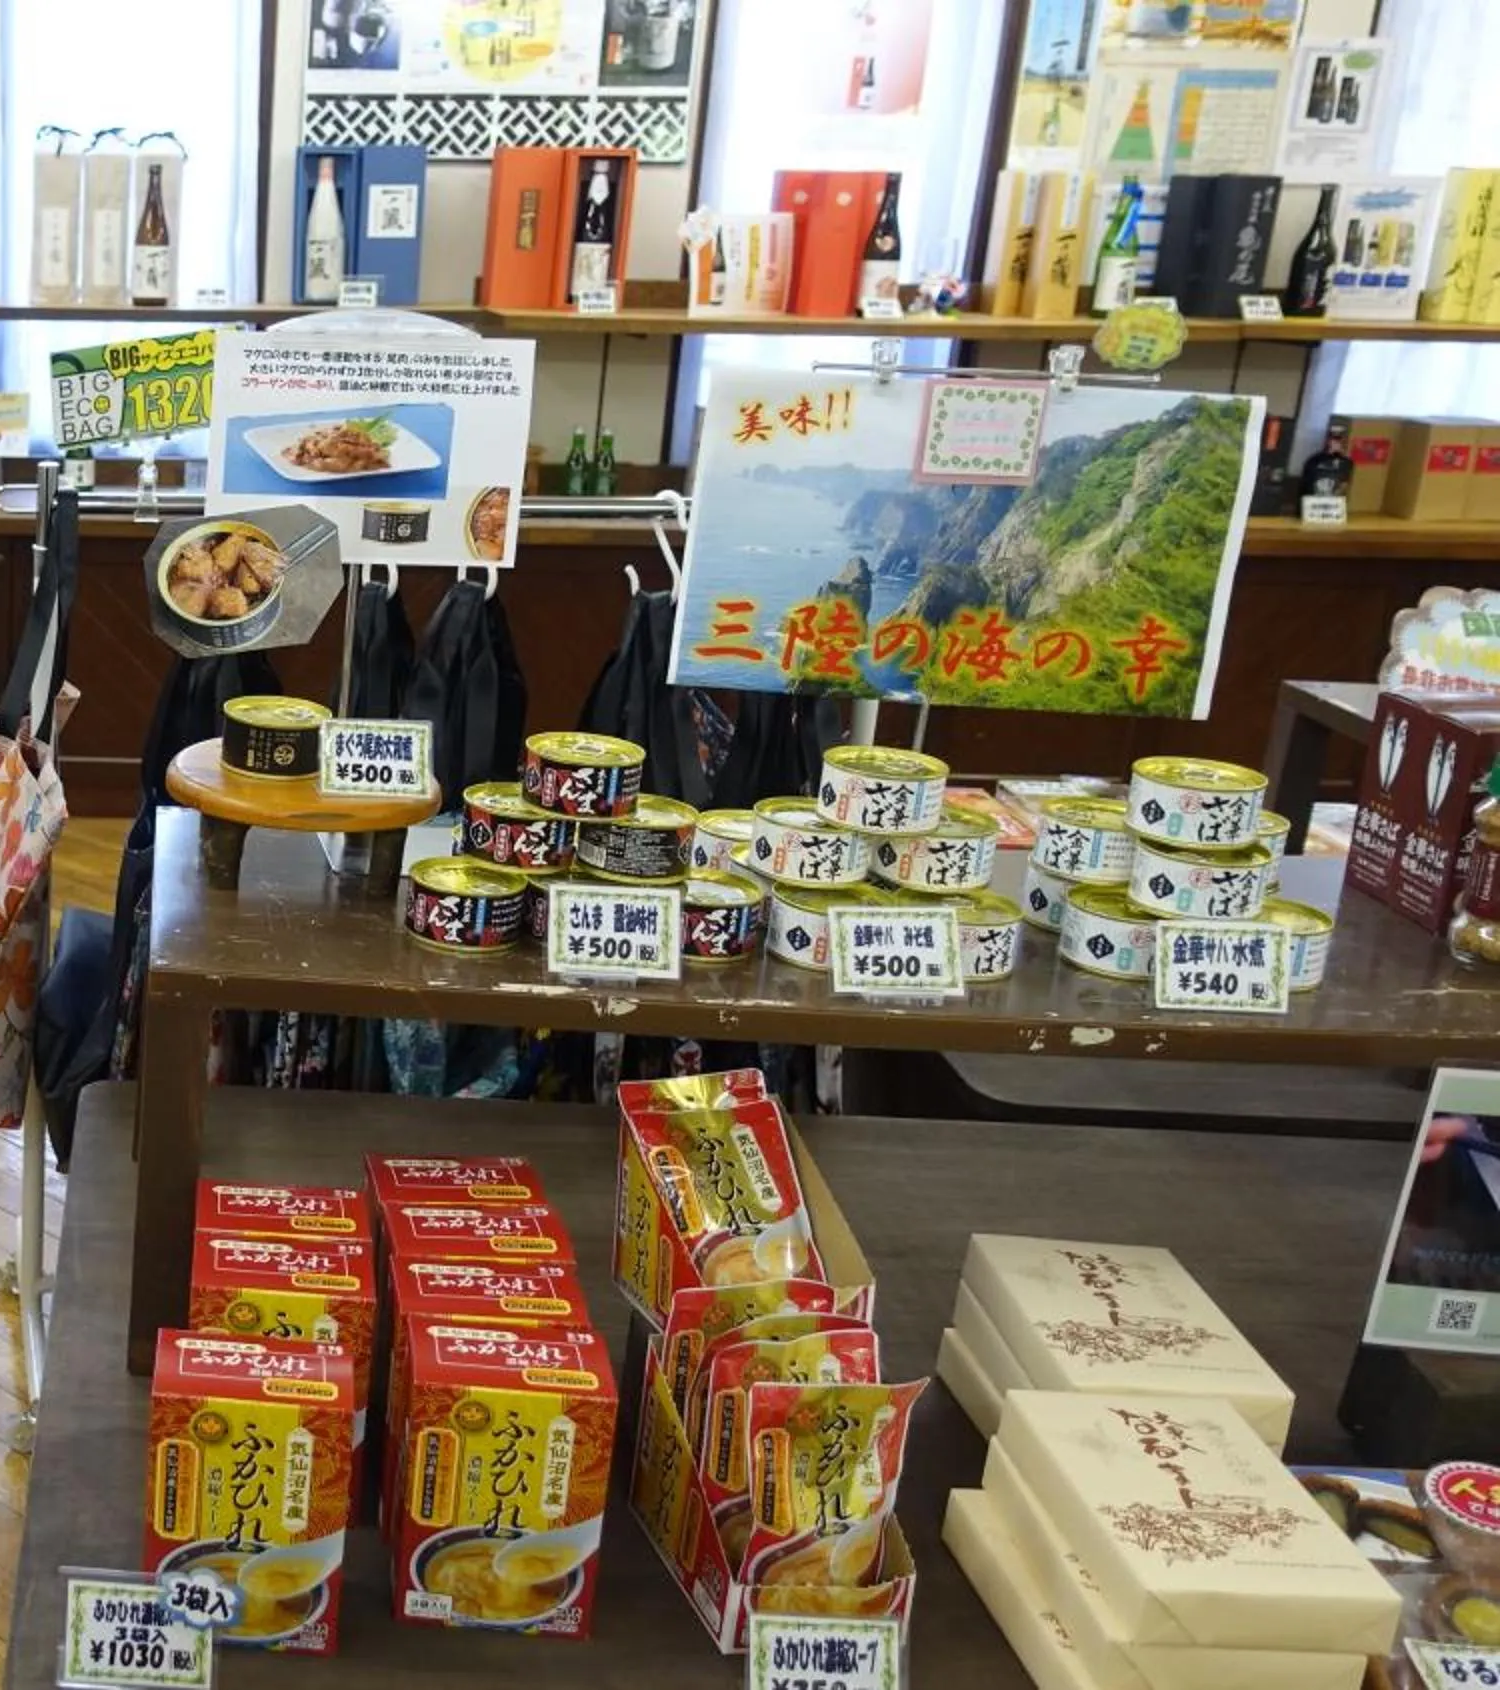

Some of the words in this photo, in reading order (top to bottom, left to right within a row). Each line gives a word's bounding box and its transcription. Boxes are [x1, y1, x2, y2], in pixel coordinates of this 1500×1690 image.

[62, 416, 113, 443] BAG
[695, 599, 1188, 697] 三陸の海の幸
[336, 763, 393, 784] ¥500
[568, 936, 633, 960] ¥500
[854, 955, 921, 977] ¥500
[1178, 972, 1238, 995] ¥540
[226, 1423, 276, 1546] ふかひれ
[484, 1410, 537, 1532] ふかひれ
[90, 1641, 165, 1669] ¥1030
